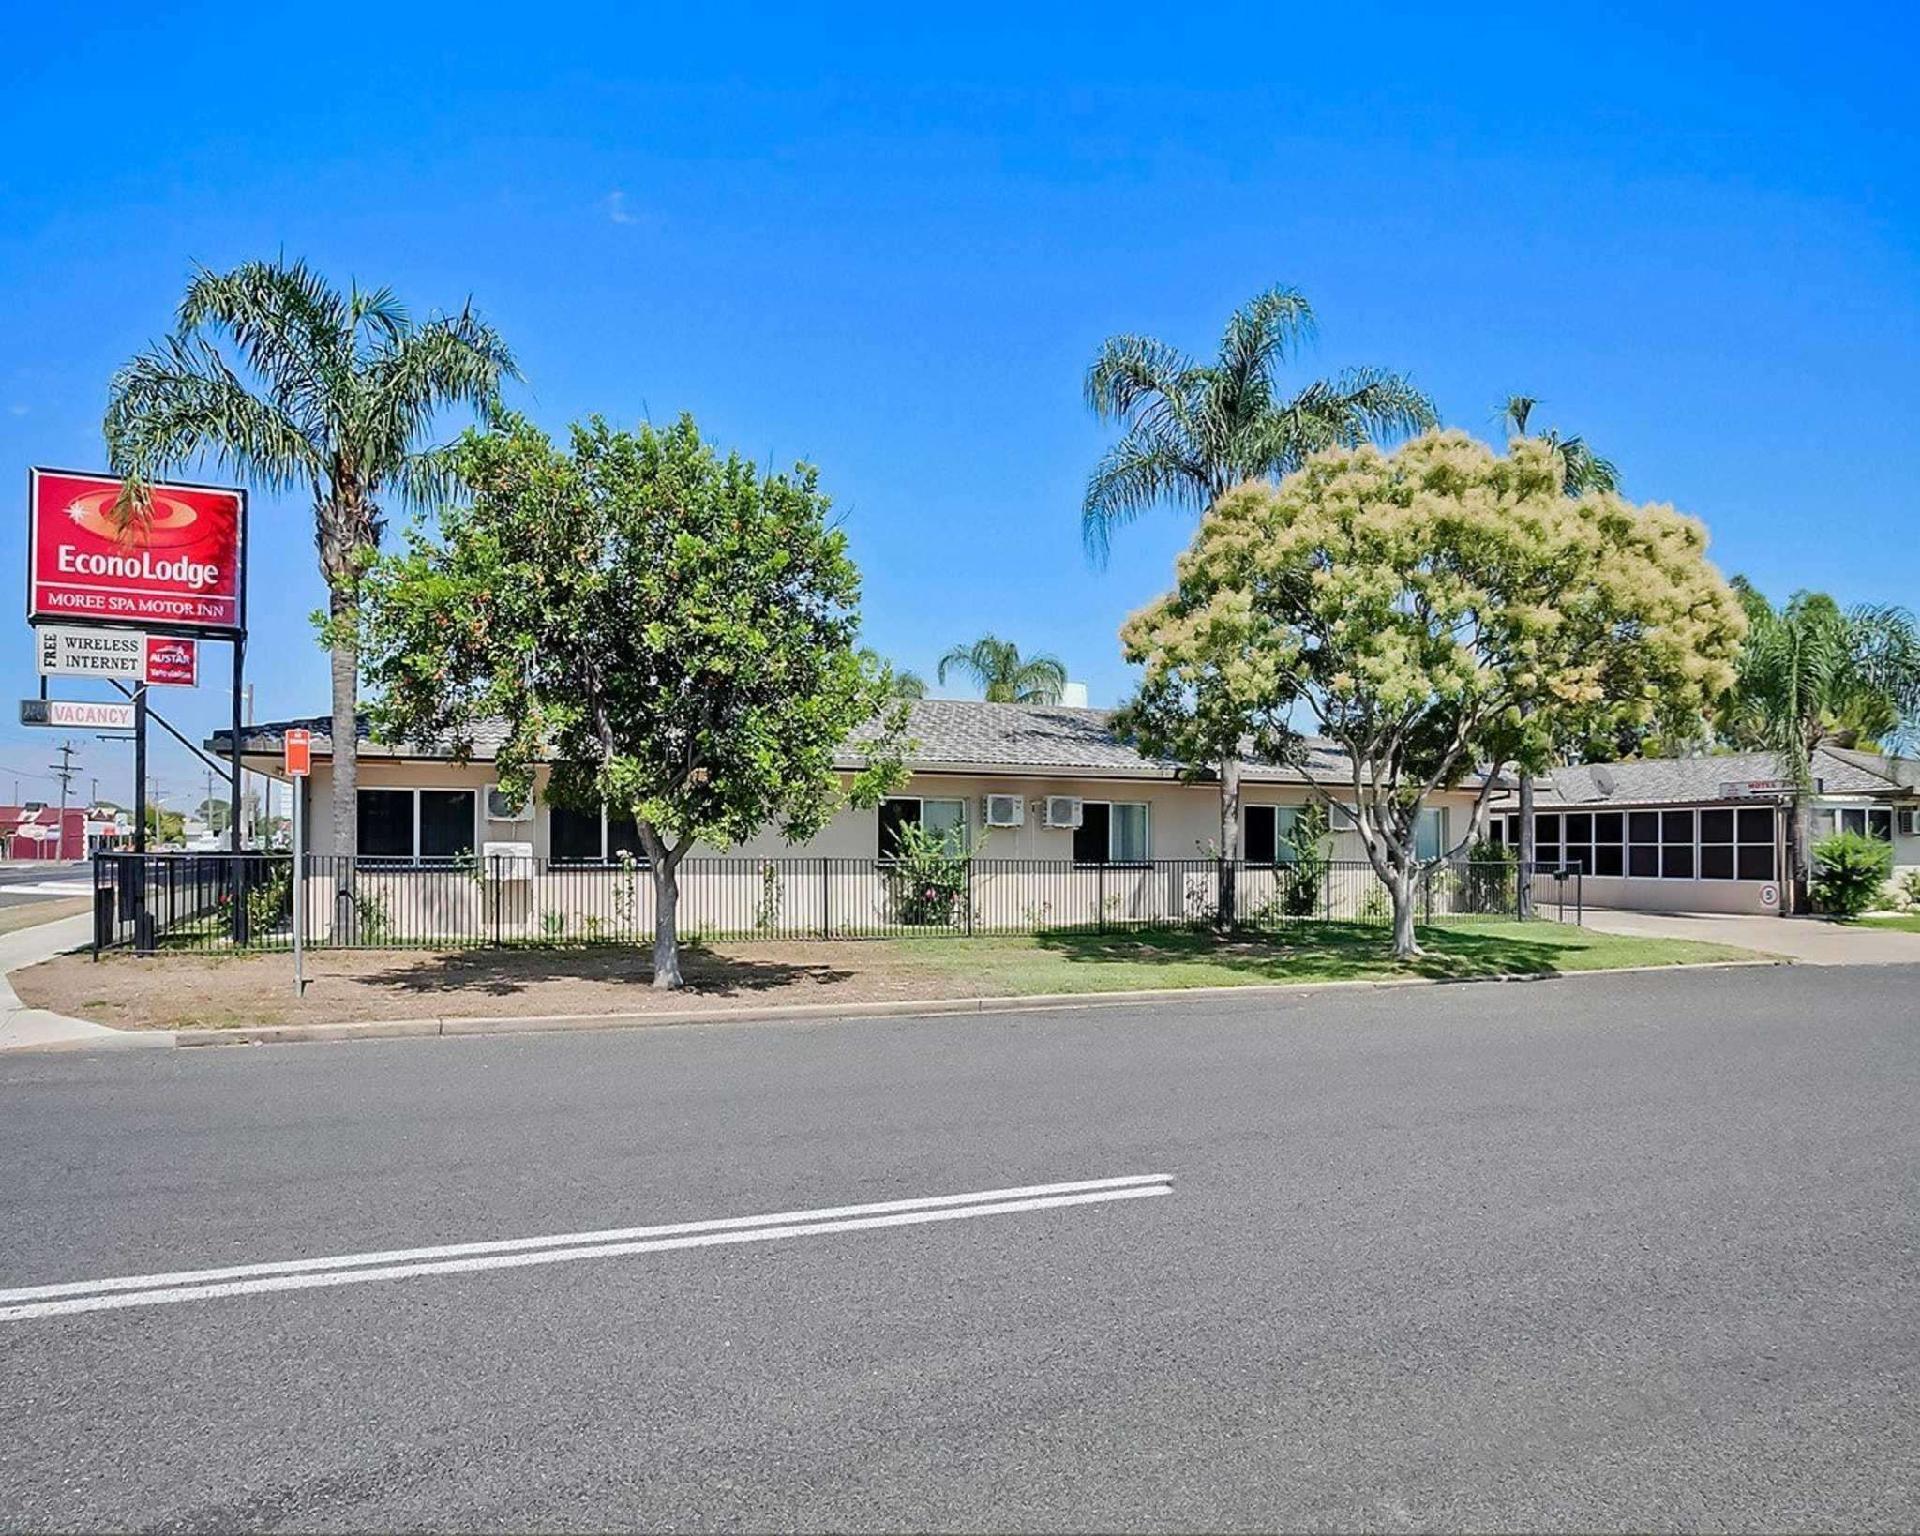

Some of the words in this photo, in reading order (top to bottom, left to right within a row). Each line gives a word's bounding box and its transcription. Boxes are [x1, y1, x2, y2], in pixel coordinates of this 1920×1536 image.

[58, 544, 219, 589] EconoLodge
[48, 592, 106, 609] MOREE
[108, 598, 136, 611] SPA
[139, 599, 195, 614] MOTOR
[197, 604, 224, 617] INN
[44, 633, 57, 668] FREE
[65, 636, 139, 652] WIRELESS
[65, 655, 138, 670] INTERNET
[150, 653, 190, 665] AUSTAR
[55, 705, 129, 724] VACANCY
[1765, 890, 1773, 900] 5
